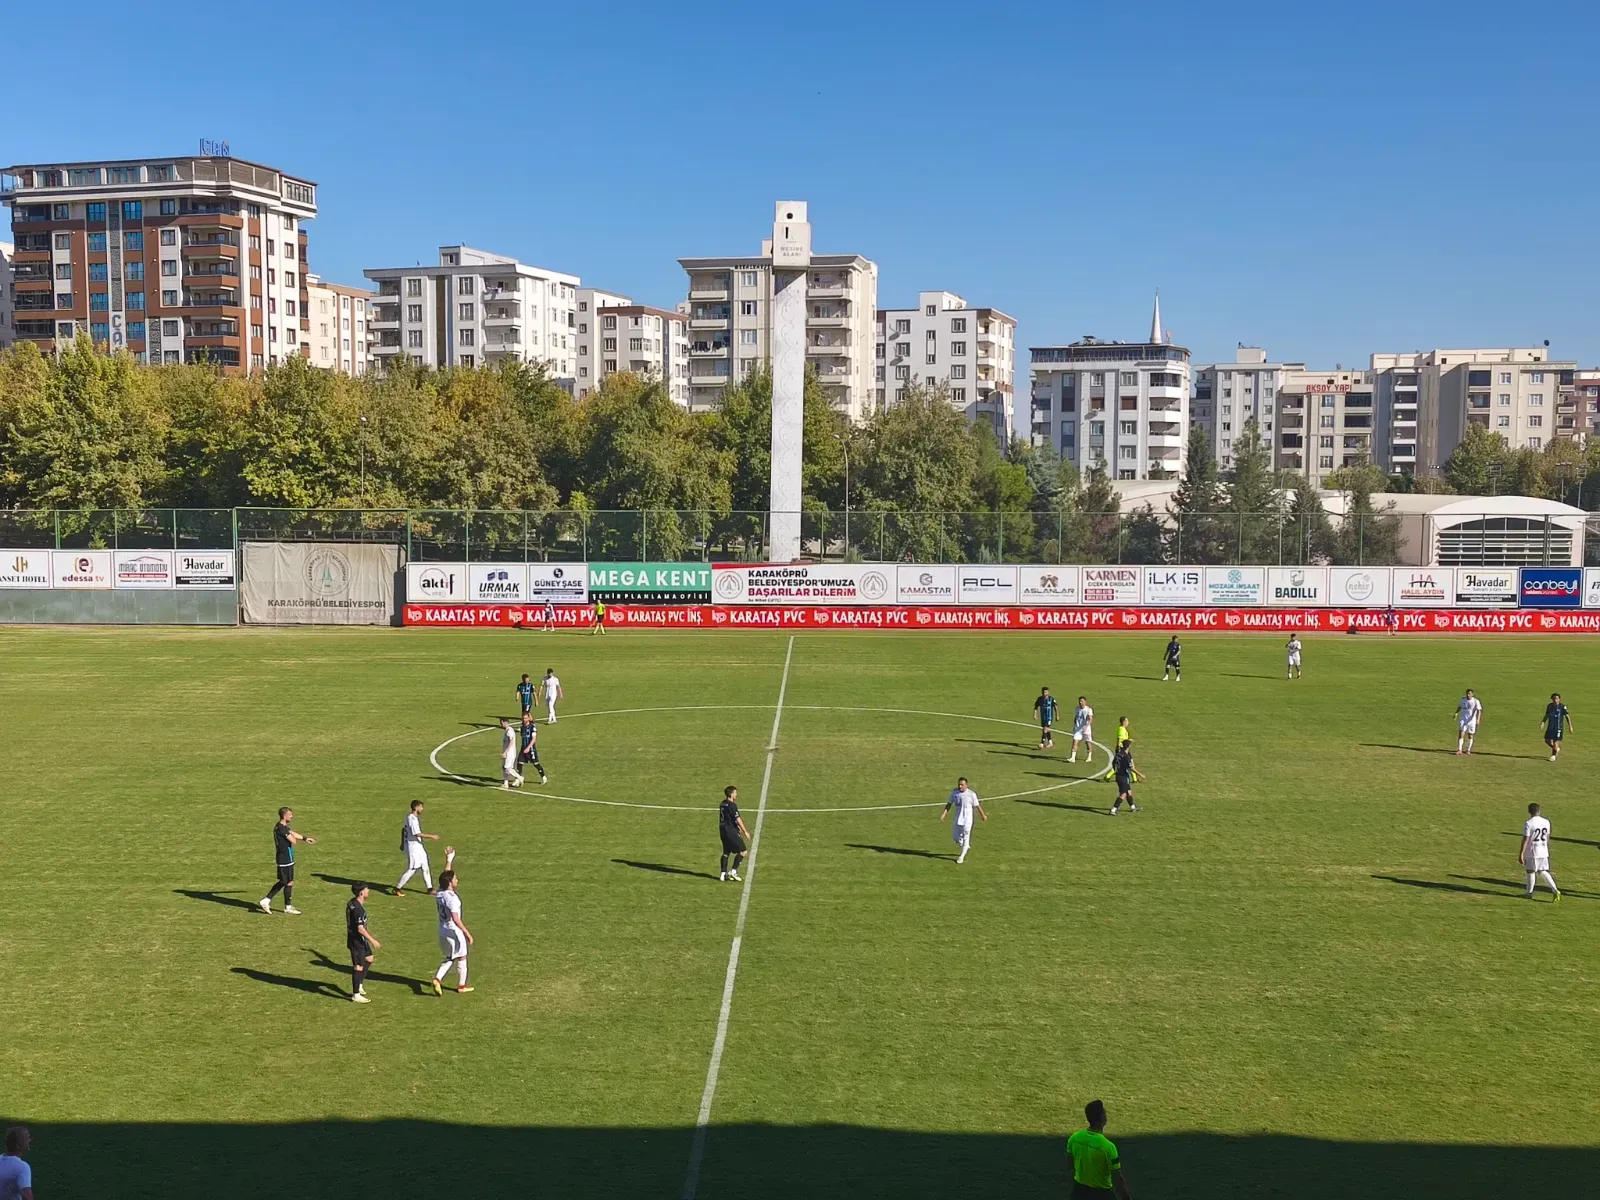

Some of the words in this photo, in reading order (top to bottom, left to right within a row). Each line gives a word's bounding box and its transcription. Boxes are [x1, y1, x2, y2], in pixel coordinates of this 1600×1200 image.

[1306, 384, 1331, 392] AKSOY
[1334, 384, 1352, 392] YAPI
[183, 558, 225, 570] Havadar
[590, 570, 650, 586] MEGA
[656, 570, 710, 586] KENT
[748, 569, 808, 578] KARAKÖPRÜ
[1085, 570, 1137, 581] KARMEN
[422, 574, 456, 595] aktif
[479, 582, 520, 592] URMAK
[534, 579, 560, 587] GÜNEY
[560, 580, 582, 588] ŞASE
[963, 578, 1012, 587] ACL
[1466, 575, 1509, 587] Havadar
[748, 588, 810, 597] BAŞARILAR
[1275, 588, 1317, 598] BADILLI
[268, 598, 322, 608] KARAKÖPRÜ
[323, 598, 386, 608] BELEDİYESPOR
[426, 609, 475, 624] KARATAŞ
[479, 609, 500, 622] PVC
[580, 610, 598, 622] PV
[628, 610, 666, 625] KARATAŞ
[668, 610, 686, 622] PVC
[730, 611, 780, 626] KARATAŞ
[784, 611, 806, 623] PVC
[832, 611, 882, 626] KARATAŞ
[886, 611, 908, 624] PVC
[934, 612, 972, 626] KARATAŞ
[976, 612, 992, 624] PVC
[1038, 612, 1088, 628] KARATAŞ
[1092, 612, 1114, 624] PVC
[1141, 613, 1191, 628] KARATAŞ
[1196, 613, 1217, 625] PVC
[1244, 614, 1282, 628] KARATAŞ
[1285, 614, 1302, 626] PVC
[1348, 614, 1400, 630] KARATŞ
[1404, 615, 1426, 626] PVC
[1453, 615, 1506, 630] KARATAŞ
[1510, 616, 1532, 627] PVC
[1560, 616, 1600, 630] KARATAŞ
[1533, 828, 1548, 842] 28
